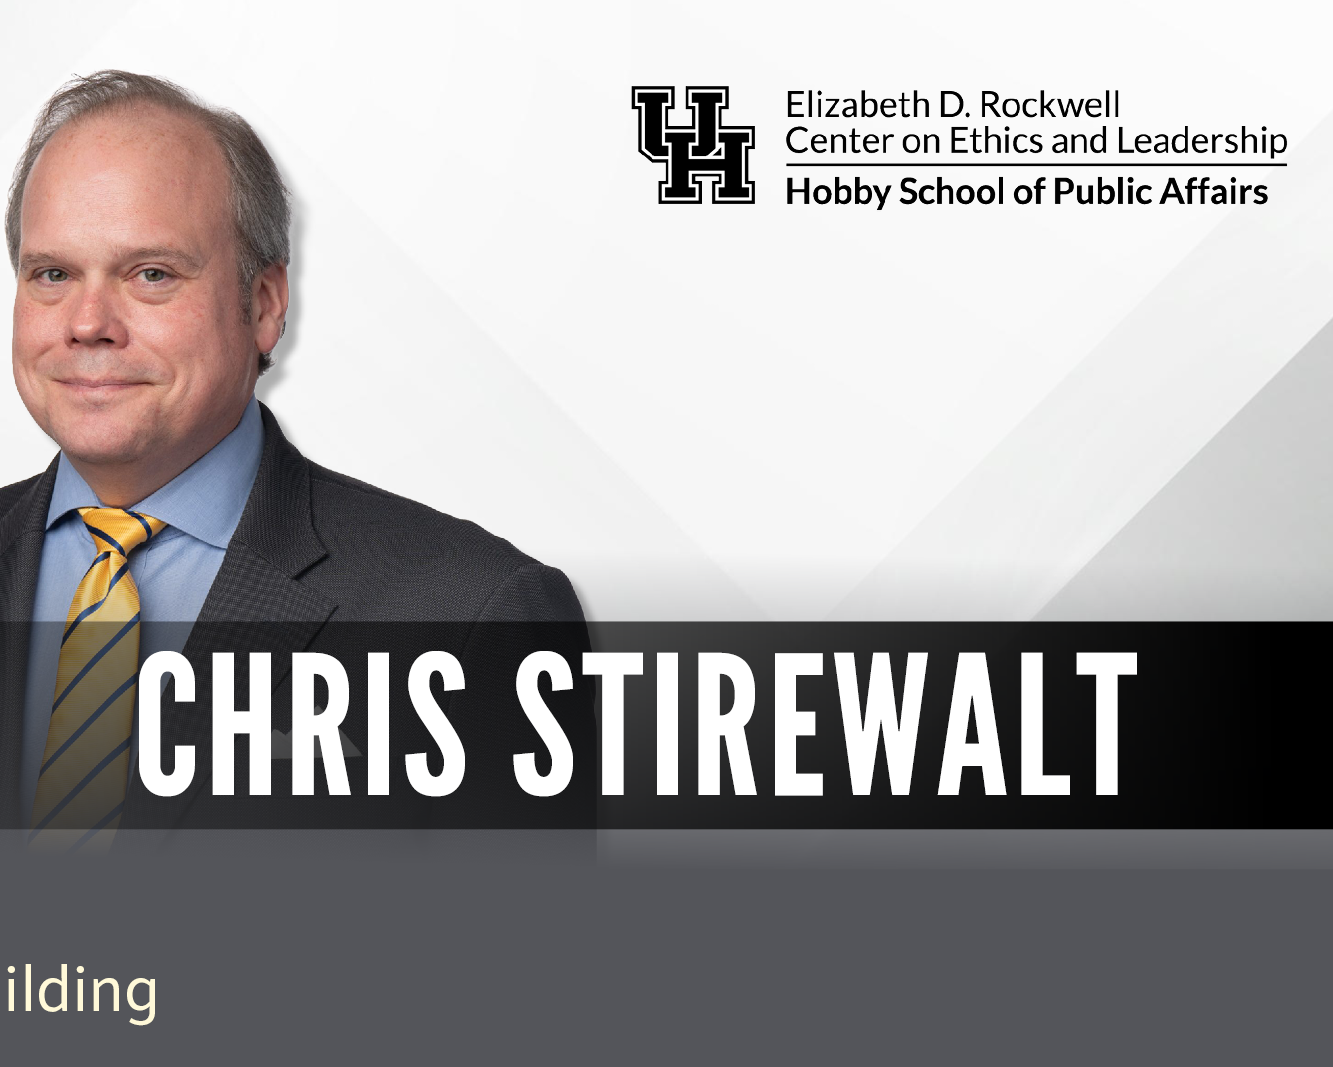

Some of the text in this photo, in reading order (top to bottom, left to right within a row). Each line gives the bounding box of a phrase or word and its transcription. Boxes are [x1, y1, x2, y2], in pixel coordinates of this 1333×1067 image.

[787, 89, 1120, 118] Elizabeth D. Rockwell
[785, 125, 1288, 160] Center on Ethics and Leadership
[786, 176, 1269, 211] Hobby School of Public Affairs
[137, 650, 1138, 797] CHRIS STIREWALT
